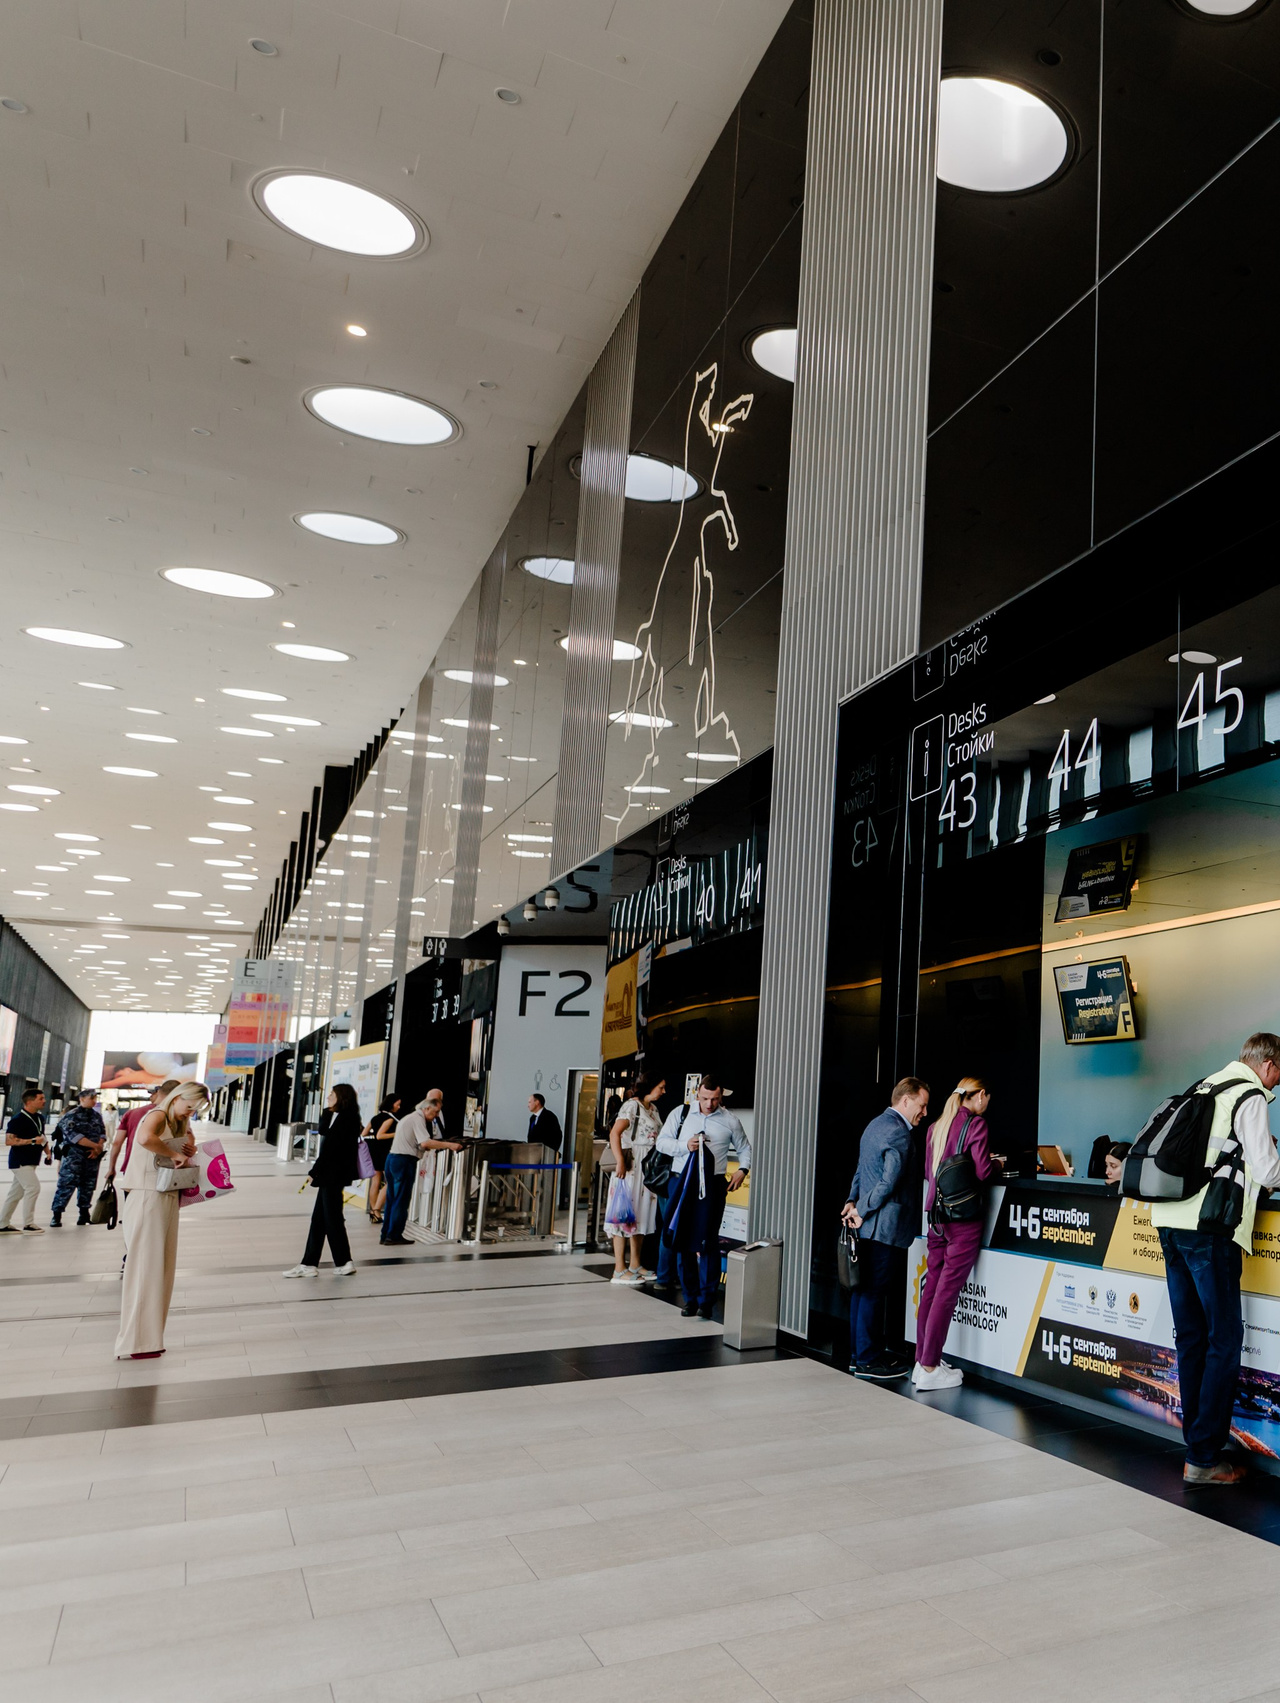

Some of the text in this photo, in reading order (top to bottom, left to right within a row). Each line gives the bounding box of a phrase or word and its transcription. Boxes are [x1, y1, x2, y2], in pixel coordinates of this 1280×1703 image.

[1177, 656, 1244, 741] 45
[948, 702, 987, 738] Desks
[947, 731, 995, 767] Стойки
[1048, 718, 1099, 791] 44
[938, 772, 977, 832] 43
[670, 855, 687, 874] Desks
[740, 863, 761, 908] 41
[696, 883, 716, 925] 40
[244, 962, 257, 977] E
[518, 970, 592, 1017] F2
[1075, 995, 1113, 1007] Регистрация
[1078, 1006, 1113, 1018] Registration
[1122, 1010, 1132, 1032] F
[1009, 1203, 1089, 1240] 4-6 сентября
[1042, 1225, 1096, 1246] september
[1133, 1248, 1138, 1256] и
[1042, 1330, 1117, 1366] 4-6 сентября
[1072, 1353, 1122, 1379] september
